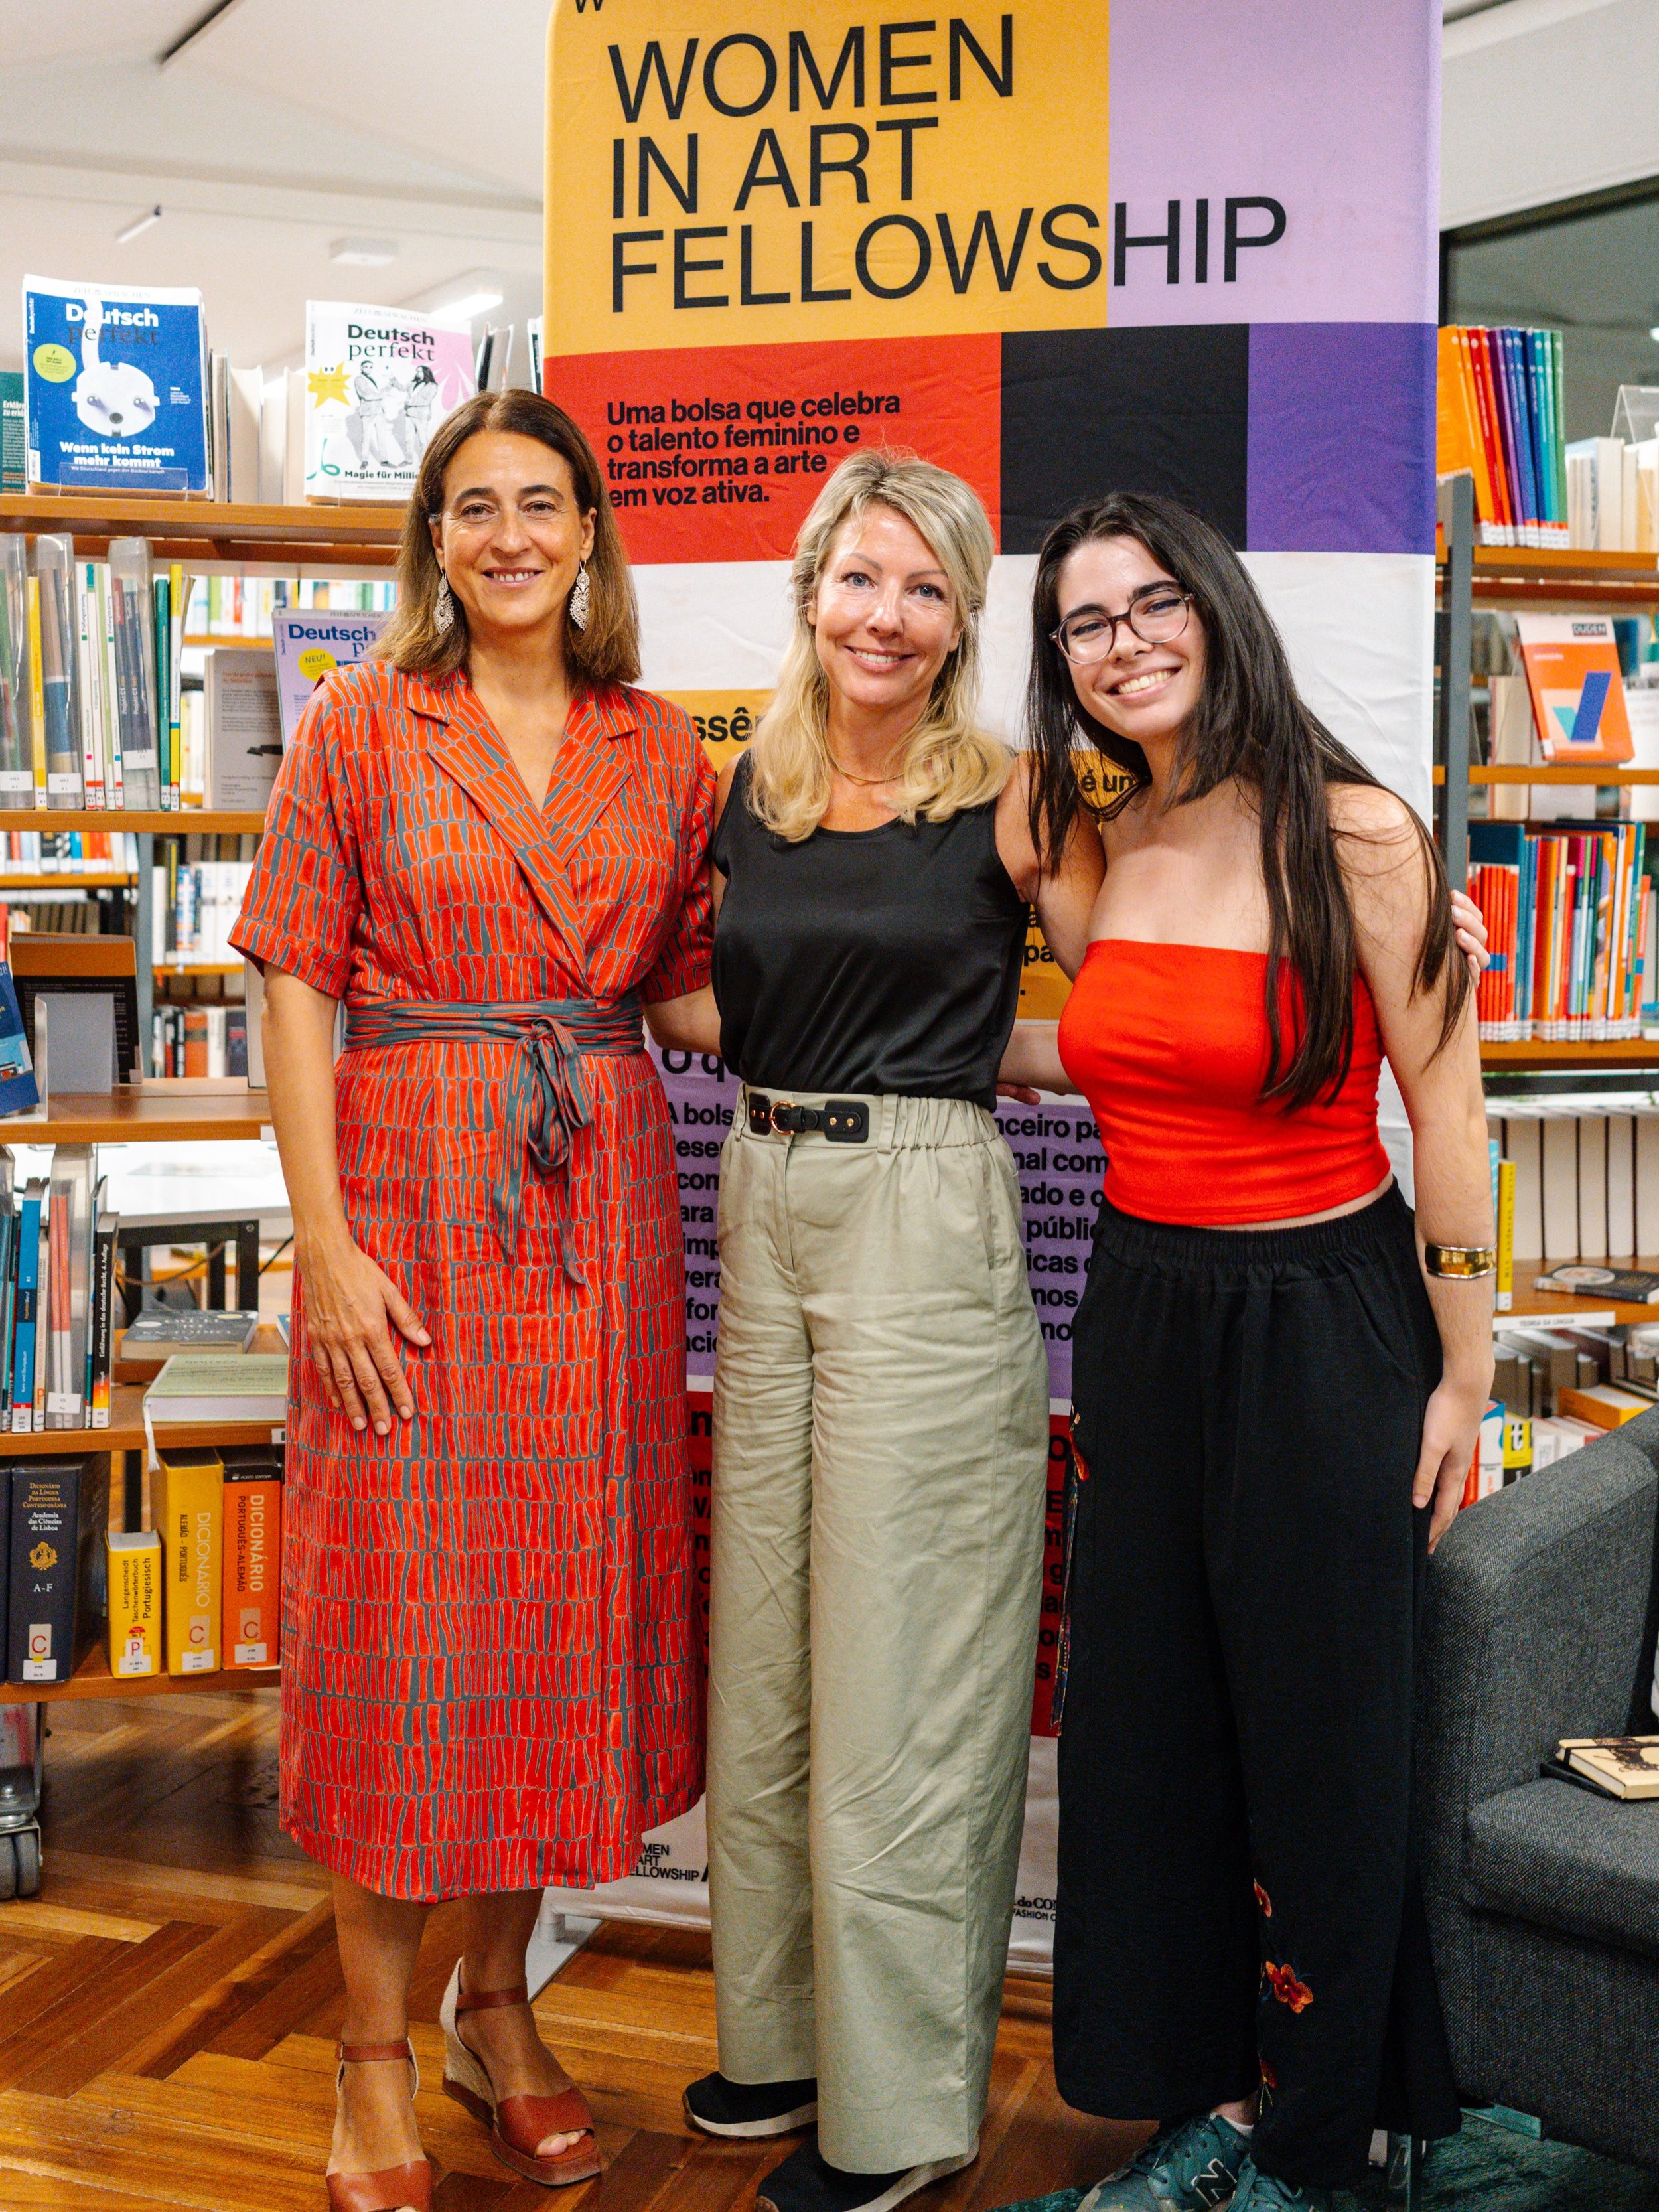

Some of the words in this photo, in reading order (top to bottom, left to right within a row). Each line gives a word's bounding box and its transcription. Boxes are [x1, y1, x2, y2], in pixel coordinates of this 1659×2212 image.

[608, 14, 1013, 123] WOMEN
[612, 133, 698, 219] IN
[735, 117, 939, 211] ART
[612, 196, 1287, 313] FELLOWSHIP
[68, 325, 157, 345] perfekt
[348, 325, 435, 346] Deutsch
[349, 342, 435, 361] perfekt
[608, 401, 665, 425] Uma
[672, 398, 741, 423] bolsa
[747, 400, 795, 423] que
[801, 391, 900, 417] celebra
[60, 441, 99, 453] Wenn
[101, 443, 130, 455] kein
[133, 444, 175, 457] Strom
[607, 434, 624, 453] o
[629, 427, 719, 452] talento
[725, 423, 839, 448] feminino
[843, 425, 860, 443] e
[74, 455, 110, 467] mehr
[113, 456, 161, 468] kommt
[608, 453, 749, 480] transforma
[753, 457, 769, 475] a
[774, 450, 827, 474] arte
[345, 471, 374, 479] Magie
[609, 487, 647, 508] em
[653, 486, 697, 506] voz
[702, 480, 770, 504] ativa.
[288, 623, 376, 641] Deutsch
[305, 654, 325, 664] NEU!
[692, 707, 762, 742] ssê
[1081, 769, 1096, 792] é
[684, 1102, 734, 1126] bols
[674, 1136, 725, 1159] ese
[1069, 1189, 1084, 1206] e
[1027, 1216, 1097, 1242] públi
[38, 1388, 44, 1404] P
[180, 1514, 188, 1538] ALEMÃO
[236, 1495, 246, 1592] PORTUGUÊS-ALEMÃO
[250, 1495, 268, 1592] DICIONÁRIO
[179, 1546, 188, 1582] PORTUGUÊS
[33, 1583, 53, 1593] A-F
[143, 1557, 153, 1619] Portugiesisch
[190, 1626, 204, 1643] C
[244, 1621, 259, 1639] C
[32, 1635, 47, 1653] C
[131, 1641, 141, 1655] P
[643, 1843, 669, 1856] MEN
[629, 1866, 699, 1881] LLOWSHIP
